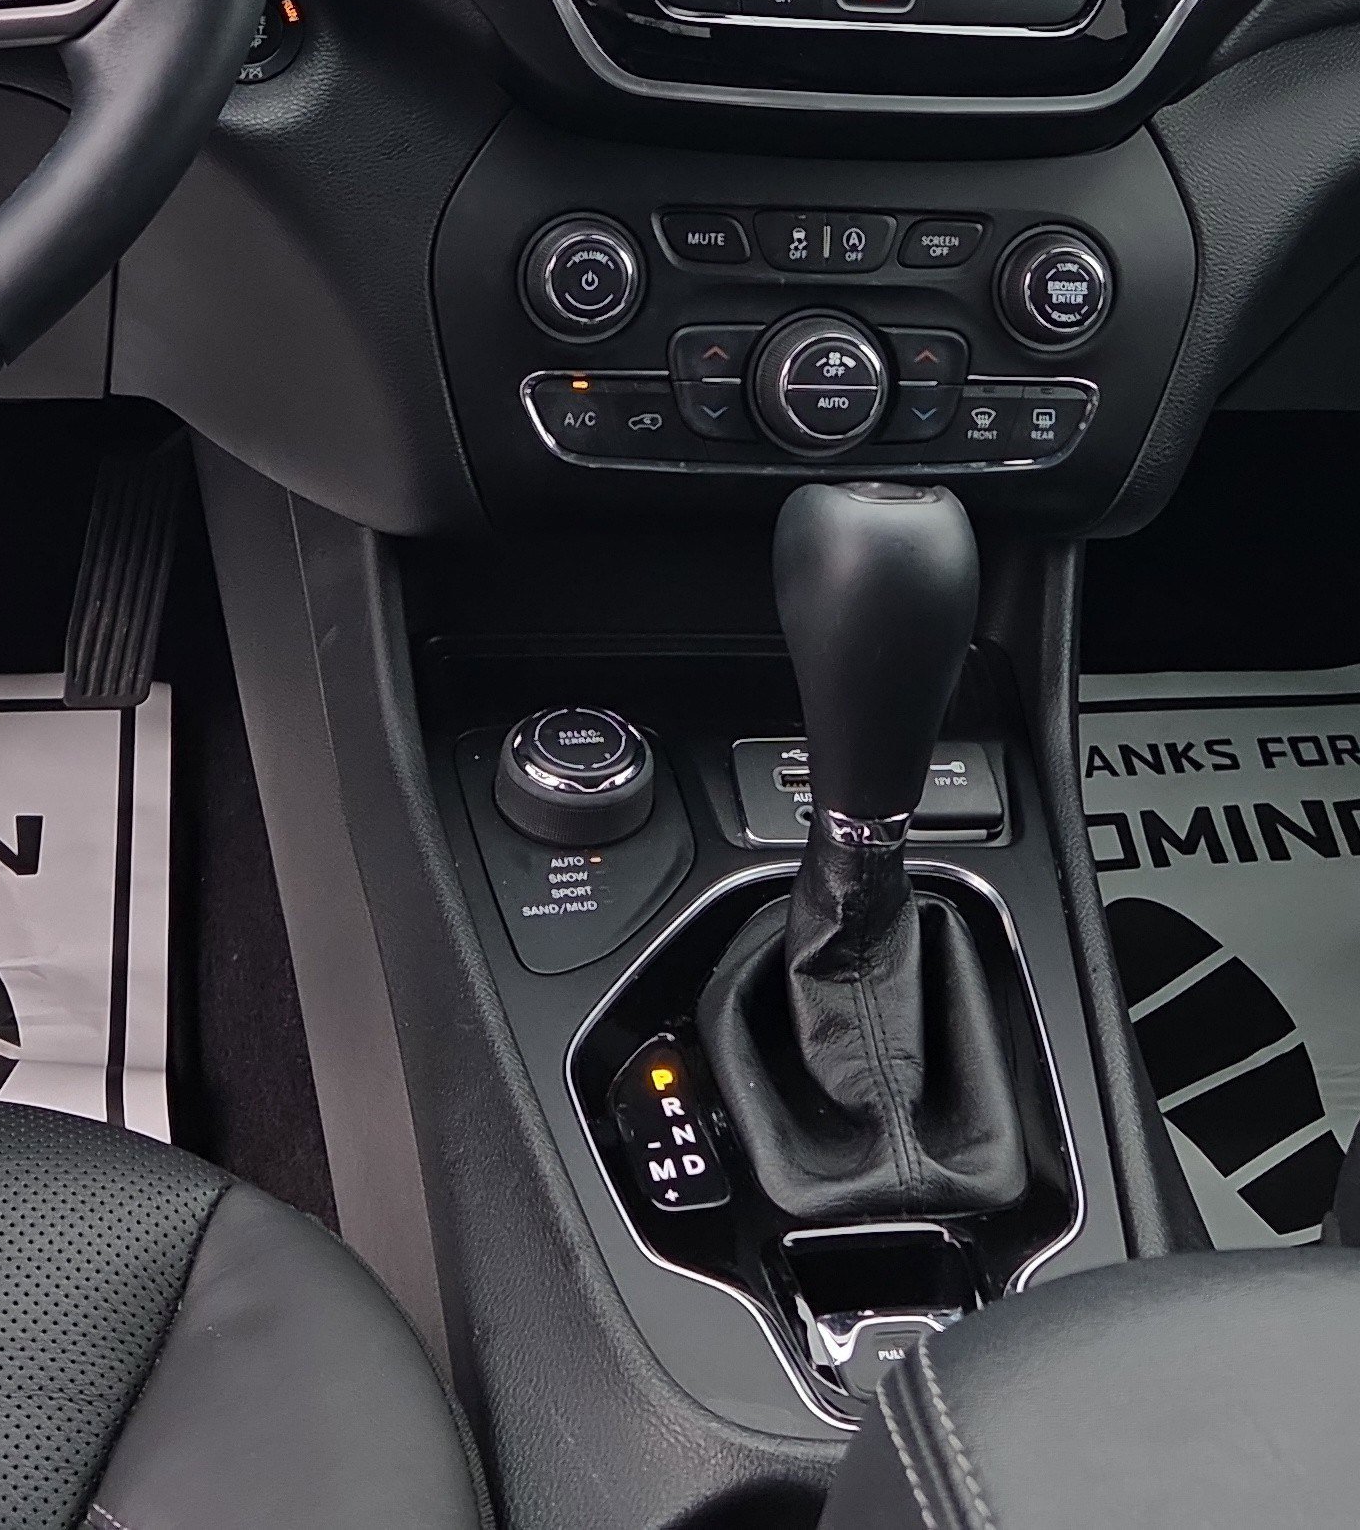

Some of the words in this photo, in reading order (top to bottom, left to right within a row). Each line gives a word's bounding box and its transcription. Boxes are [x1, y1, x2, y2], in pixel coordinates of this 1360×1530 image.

[687, 232, 725, 246] MUTE
[921, 235, 959, 247] SCREEN
[571, 250, 610, 265] VOLUME
[788, 249, 808, 260] OFF
[845, 251, 864, 262] OFF
[929, 246, 950, 257] OFF
[1047, 281, 1089, 291] BROWSE
[1052, 294, 1084, 305] ENTER
[823, 365, 846, 378] OFF
[817, 396, 850, 410] AUTO
[563, 411, 596, 428] A/C
[967, 430, 998, 440] FRONT
[1030, 430, 1055, 441] REAR
[1084, 736, 1242, 780] ANKS
[934, 776, 951, 786] 12V
[953, 776, 968, 786] DC
[551, 856, 585, 868] AUTO
[548, 870, 589, 884] SNOW
[551, 885, 592, 899] SPORT
[522, 900, 598, 917] SAND/MUD
[651, 1069, 674, 1091] P
[661, 1096, 686, 1117] R
[671, 1123, 697, 1146] N
[648, 1158, 678, 1182] M
[681, 1154, 706, 1176] D
